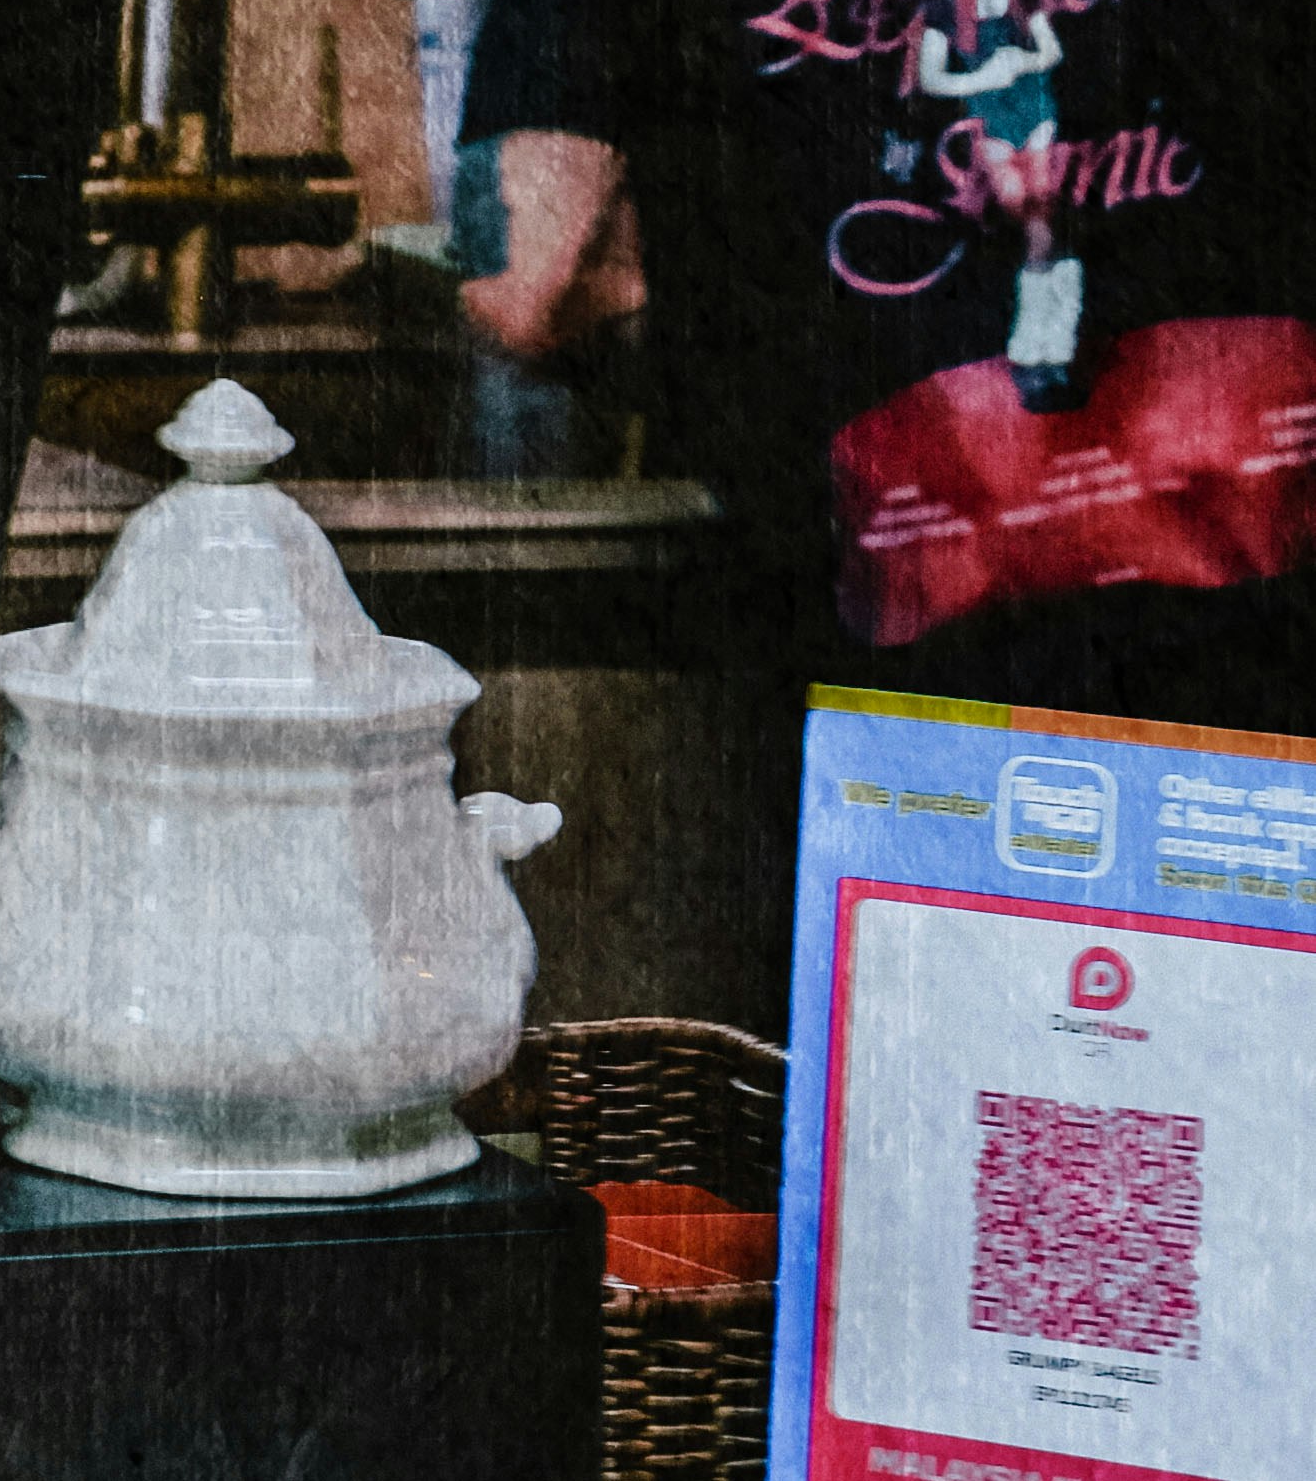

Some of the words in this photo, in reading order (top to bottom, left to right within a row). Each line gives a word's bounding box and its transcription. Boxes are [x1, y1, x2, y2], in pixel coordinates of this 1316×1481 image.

[840, 779, 892, 809] We
[896, 789, 995, 820] prefer
[1010, 774, 1106, 811] Touch
[1158, 773, 1249, 807] Other
[1185, 804, 1265, 837] bank
[1008, 1349, 1090, 1373] GRUMPY
